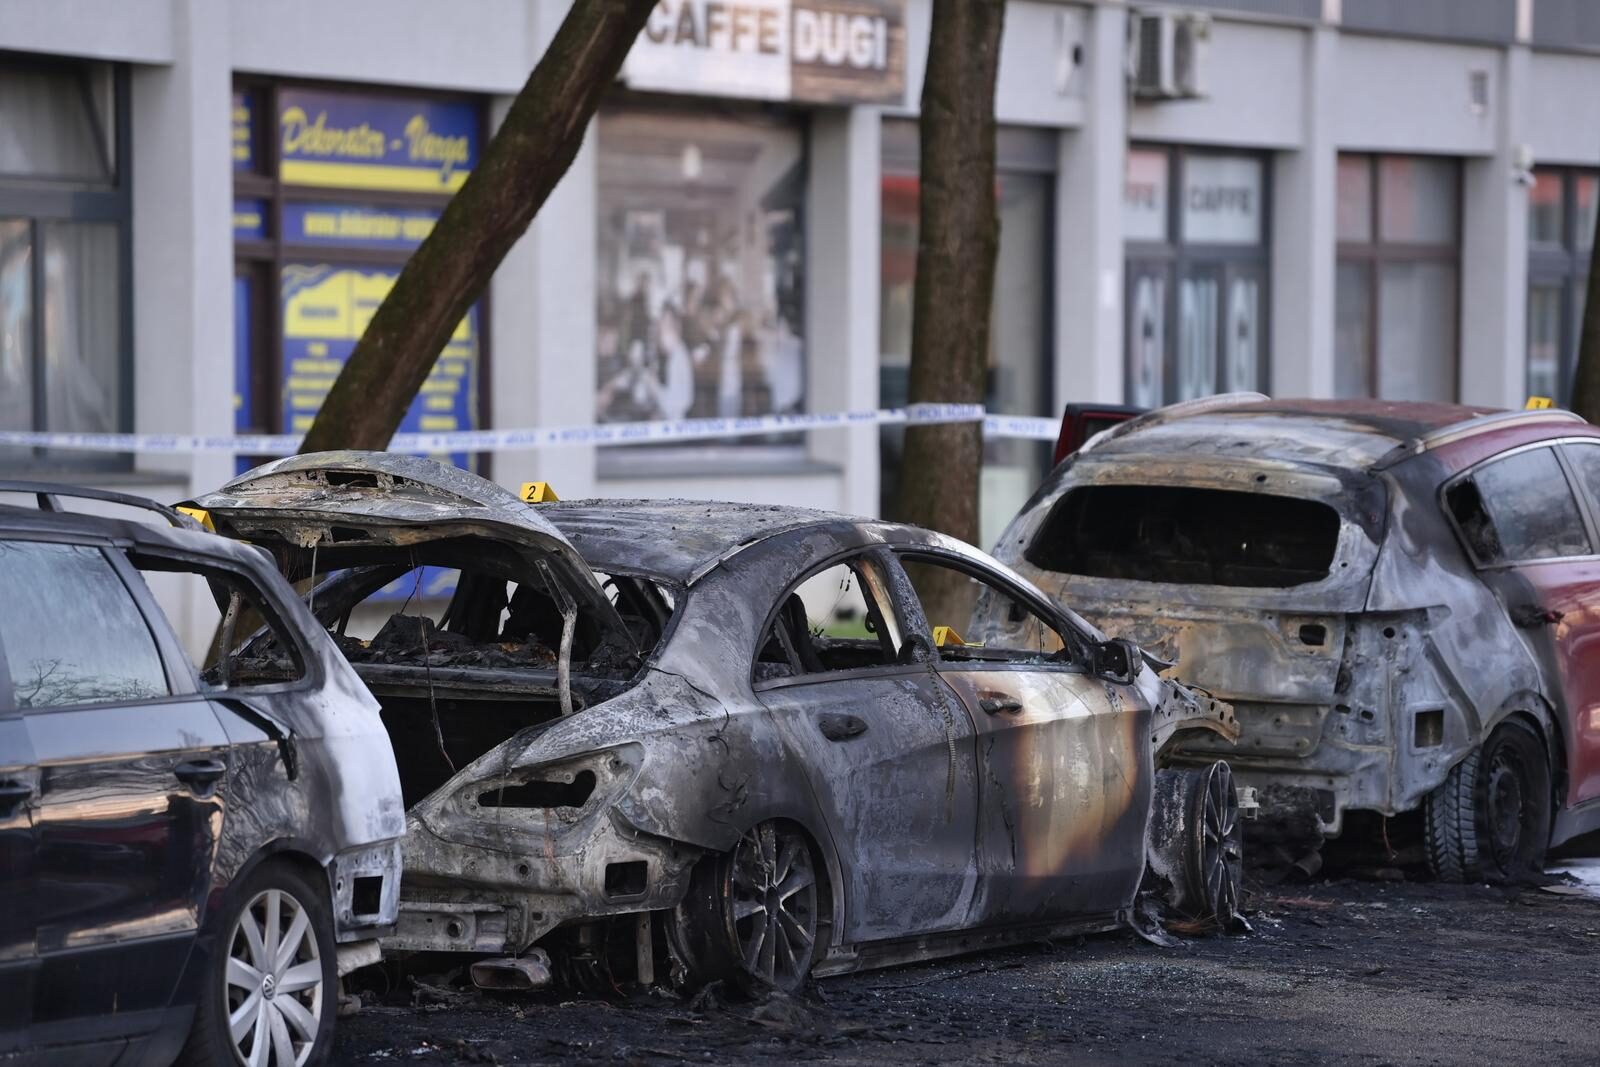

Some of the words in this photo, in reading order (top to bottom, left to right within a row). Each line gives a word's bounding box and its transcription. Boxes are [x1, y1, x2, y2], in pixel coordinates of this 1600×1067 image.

[646, 0, 780, 55] CAFFE
[795, 9, 887, 70] DUGI
[1190, 185, 1251, 214] CAFFE
[526, 485, 537, 500] 2
[936, 629, 942, 642] 1
